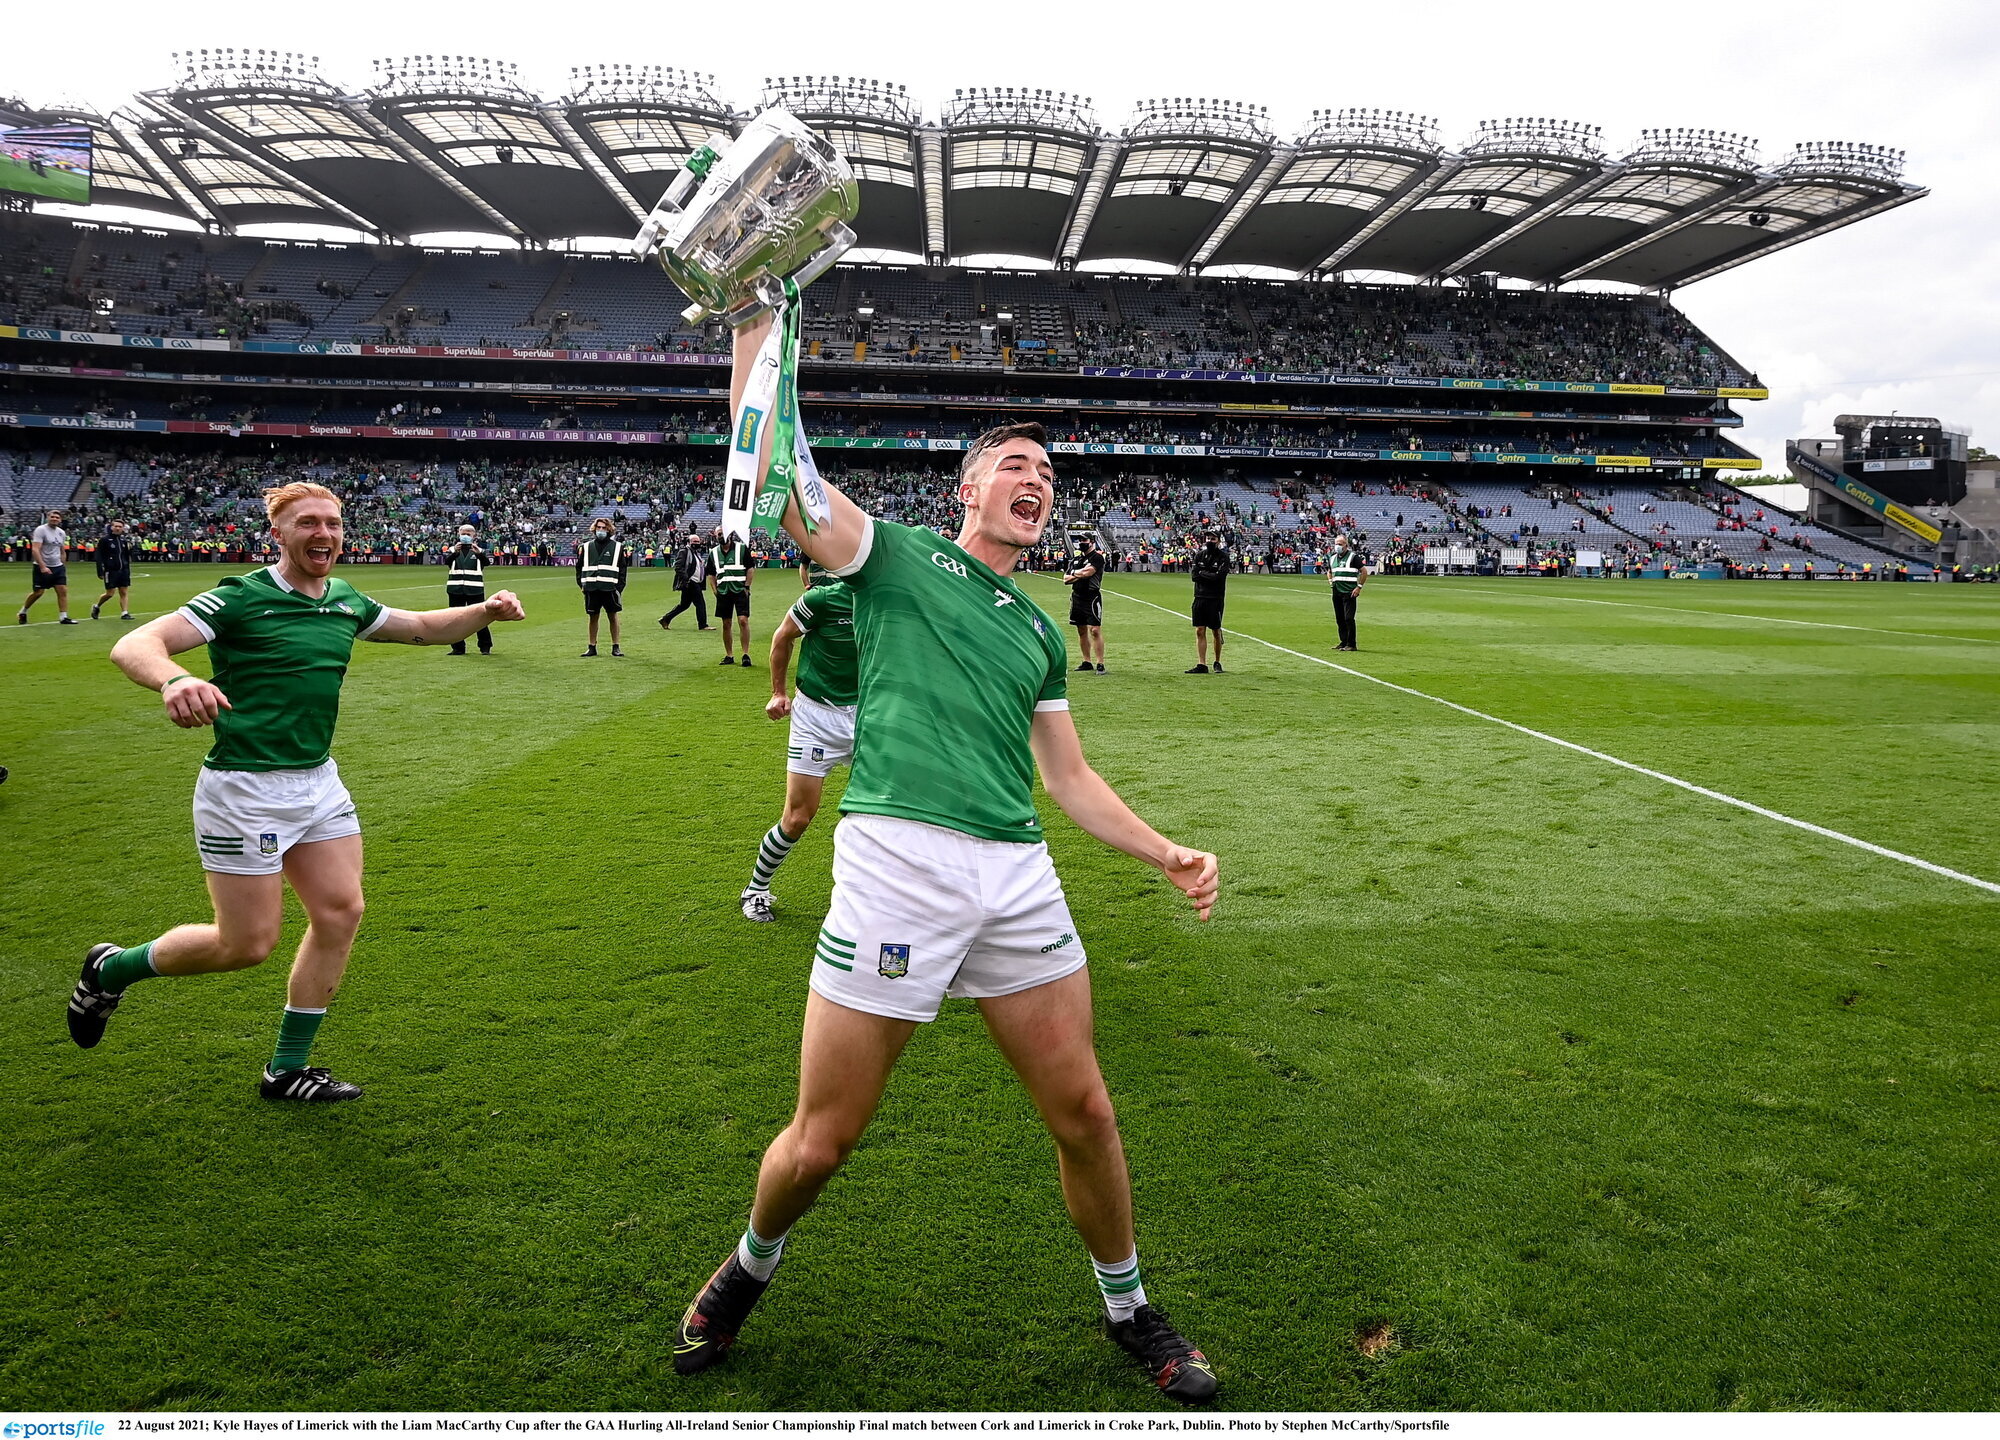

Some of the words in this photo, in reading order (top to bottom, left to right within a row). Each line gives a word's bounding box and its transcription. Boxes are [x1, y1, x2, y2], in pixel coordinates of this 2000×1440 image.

[26, 329, 52, 340] GAA
[70, 333, 94, 342] GAA
[130, 337, 154, 346] GAA
[171, 339, 192, 348] GAA
[299, 344, 318, 353] GAA
[375, 346, 416, 355] SuperValu
[444, 347, 485, 356] SuperValu
[513, 349, 554, 359] SuperValu
[582, 352, 598, 360] AIB
[616, 353, 632, 361] AIB
[650, 354, 666, 362] AIB
[683, 355, 699, 363] AIB
[718, 356, 732, 364] AIB
[1453, 380, 1483, 388] Centra
[1566, 383, 1595, 391] Centra
[51, 417, 78, 427] GAA
[209, 422, 254, 432] Supealu
[310, 425, 351, 435] SuperValu
[742, 412, 757, 448] Centra
[392, 427, 434, 437] SuperValu
[461, 430, 477, 438] AIB
[495, 430, 511, 439] AIB
[529, 431, 545, 440] AIB
[563, 432, 579, 440] AIB
[597, 432, 613, 441] AIB
[630, 433, 646, 441] AIB
[904, 439, 922, 448] GAA
[935, 440, 954, 449] GAA
[1059, 443, 1077, 452] GAA
[1090, 444, 1108, 453] GAA
[1121, 445, 1138, 453] GAA
[1151, 446, 1168, 454] GAA
[1181, 447, 1198, 455] GAA
[1241, 448, 1260, 456] Energy
[1358, 451, 1376, 459] Energy
[1391, 451, 1422, 460] Centra
[1496, 453, 1526, 462] Centra
[1551, 455, 1581, 464] Centra
[1845, 482, 1875, 506] Centra
[755, 491, 774, 516] GAA
[931, 552, 969, 579] GAA
[1669, 570, 1698, 579] Centra
